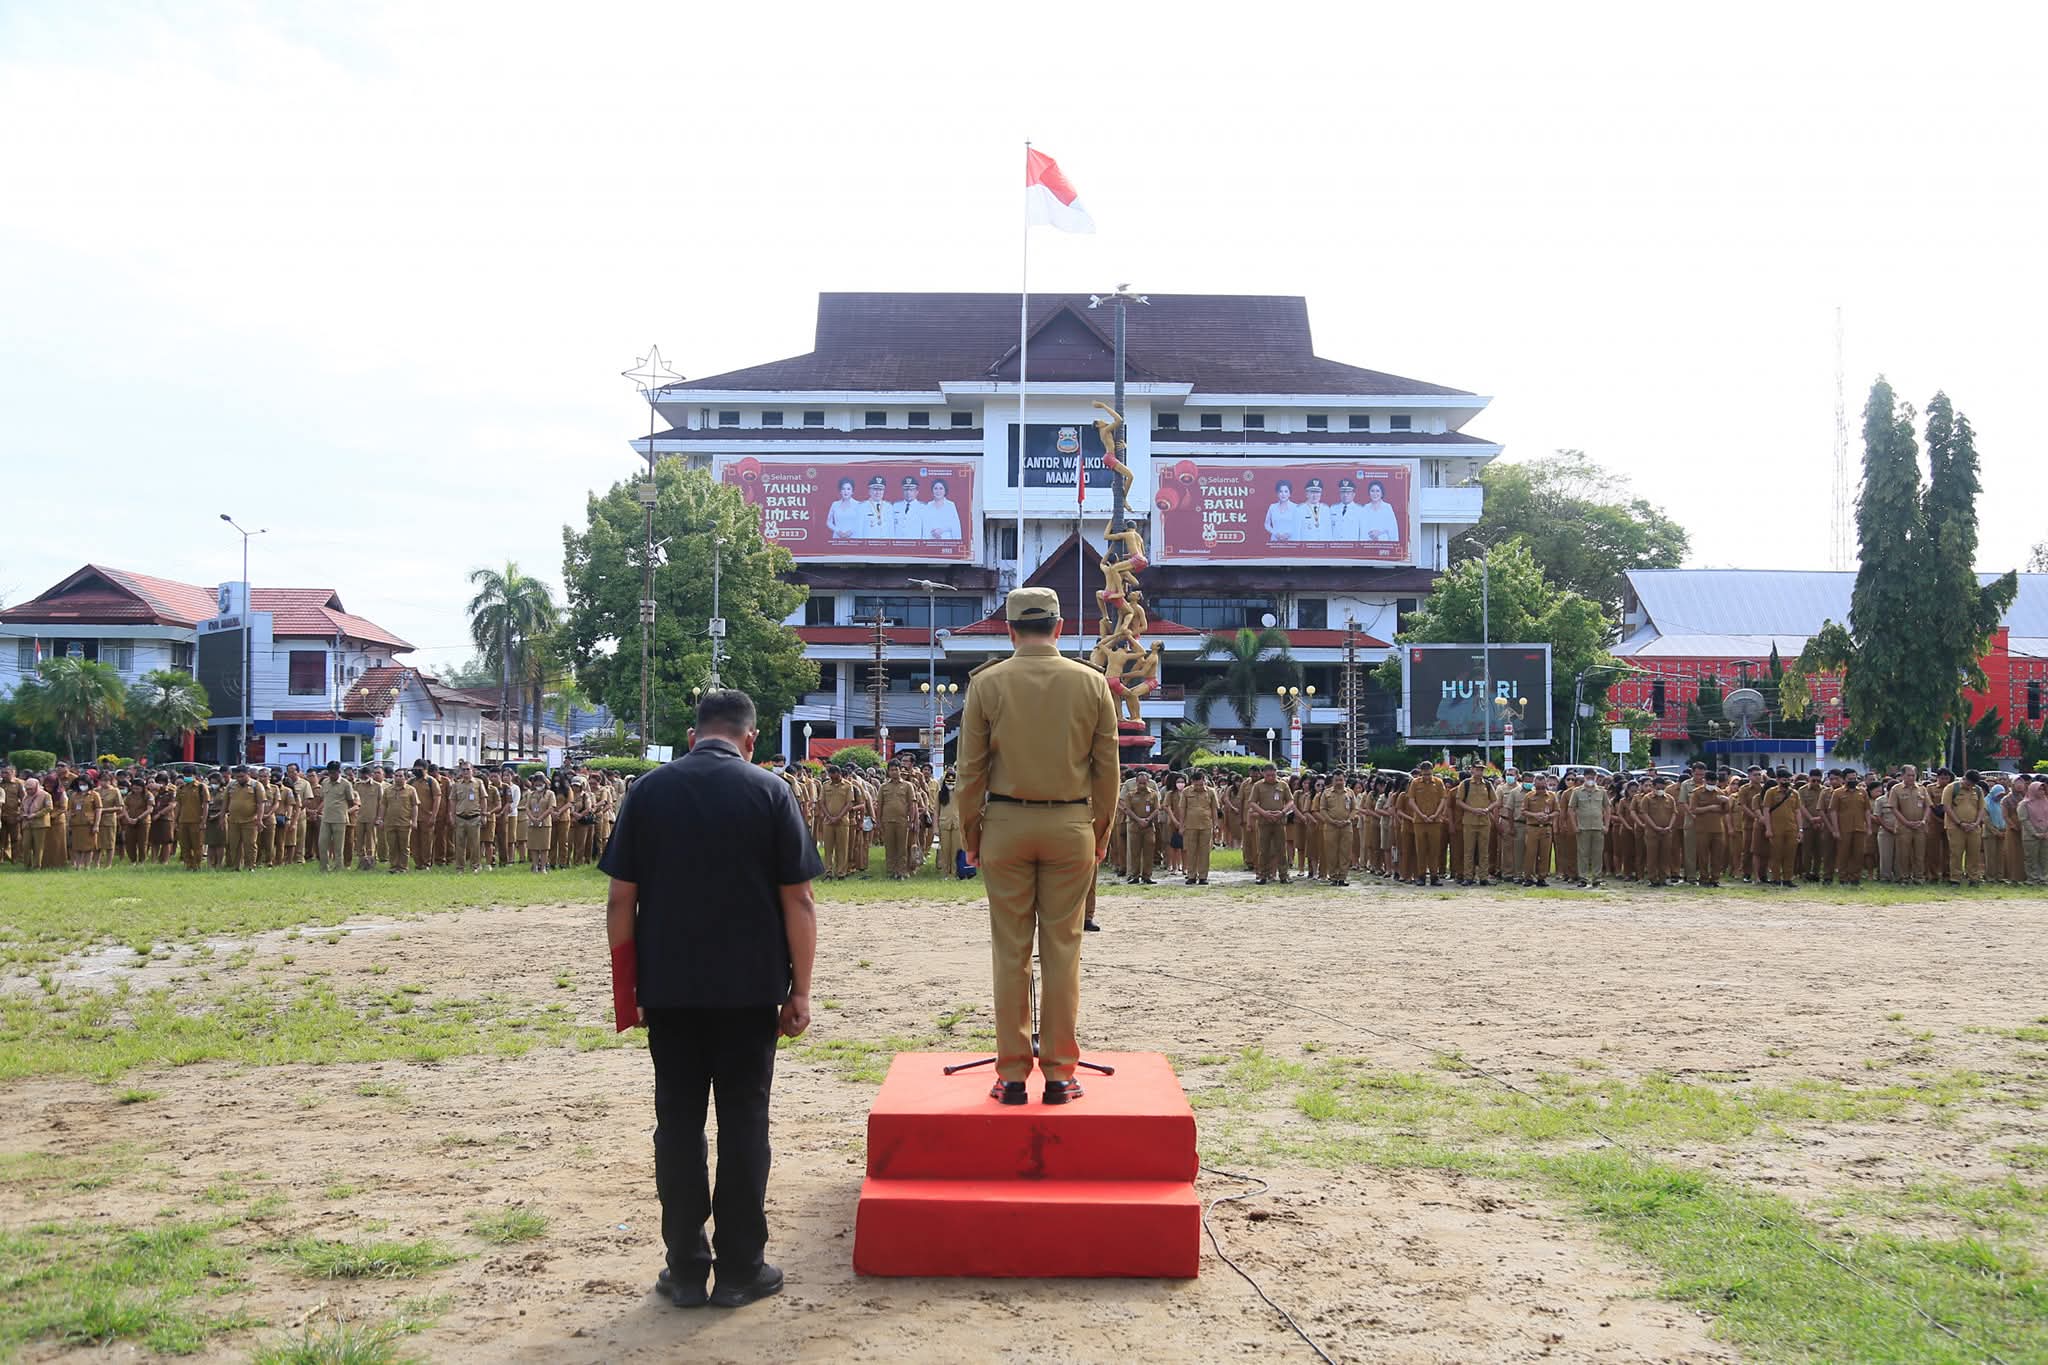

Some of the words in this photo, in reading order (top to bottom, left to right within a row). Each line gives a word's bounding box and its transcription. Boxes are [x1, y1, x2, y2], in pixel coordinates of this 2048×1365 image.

[1062, 456, 1109, 469] WAIKOT
[770, 473, 802, 481] Selamat
[1046, 471, 1090, 484] MANAO
[1207, 476, 1239, 484] Selamat
[762, 483, 811, 494] TAHUN
[1200, 486, 1249, 497] TAHUN
[766, 496, 806, 507] BARU
[1204, 499, 1244, 510] BARU
[765, 508, 810, 522] IMLEK
[1202, 511, 1248, 525] IMLEK
[1442, 680, 1486, 699] HUT
[1497, 680, 1517, 699] RI
